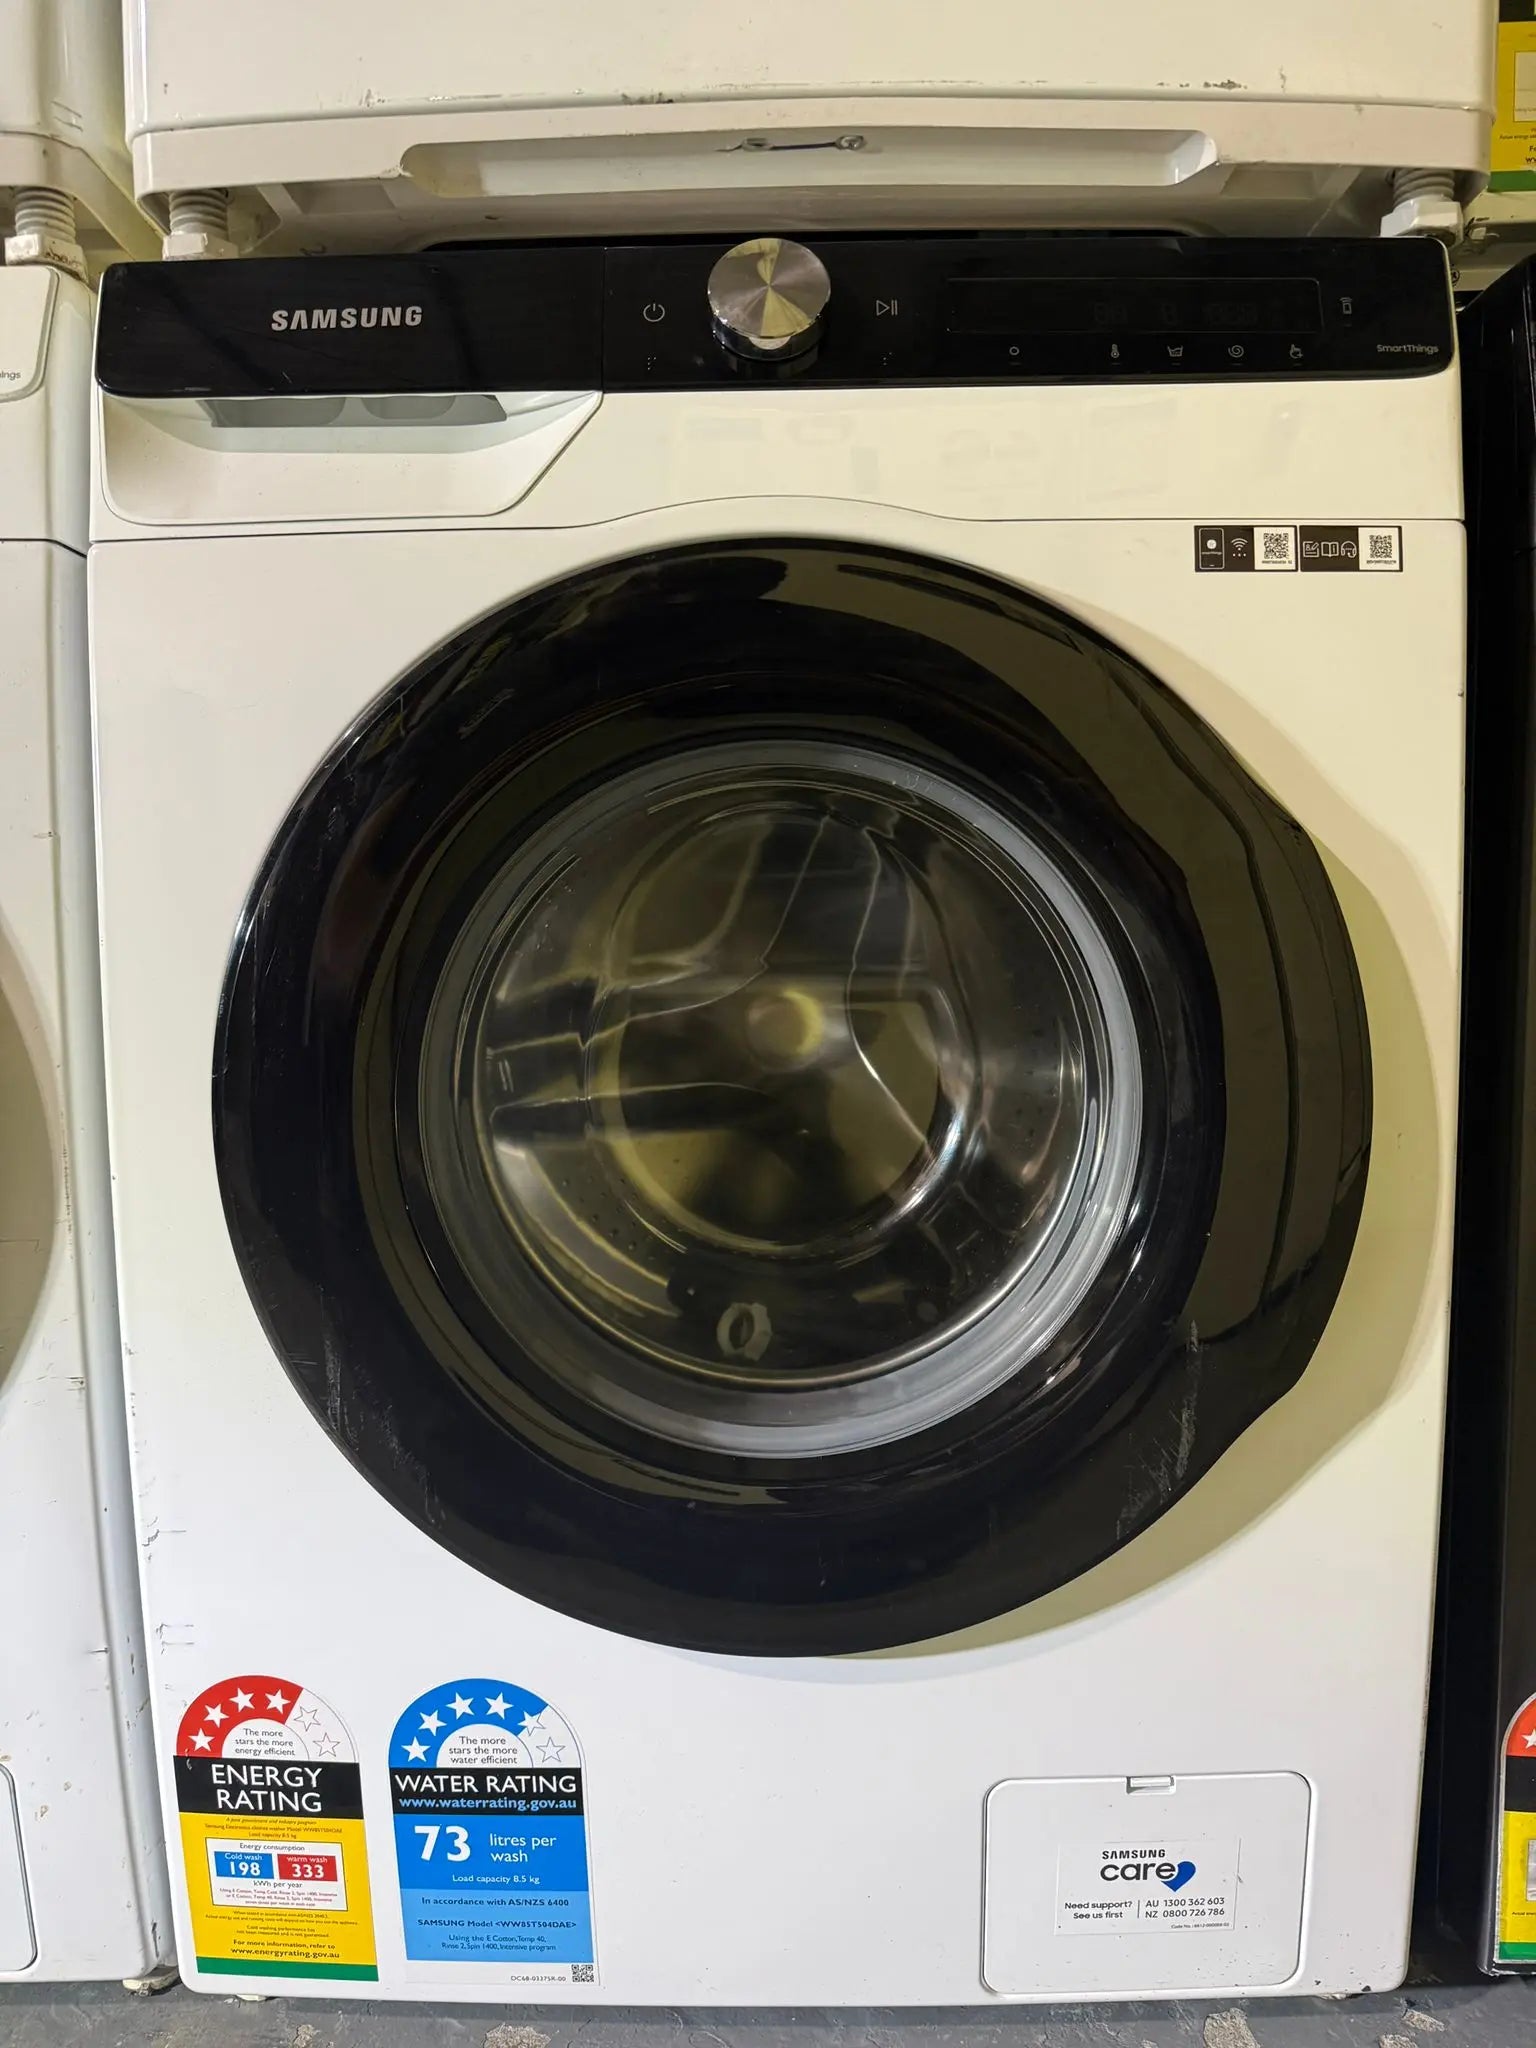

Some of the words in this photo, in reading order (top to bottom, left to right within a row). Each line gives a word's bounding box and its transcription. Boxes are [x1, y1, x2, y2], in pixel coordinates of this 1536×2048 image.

[271, 305, 423, 332] SAMSUNG
[1376, 344, 1439, 355] SmartThings
[243, 1728, 259, 1736] The
[459, 1736, 478, 1745] The
[480, 1737, 505, 1745] more
[264, 1747, 295, 1756] efficient
[474, 1746, 489, 1754] the
[480, 1756, 517, 1764] efficient
[212, 1764, 323, 1788] ENERGY
[395, 1775, 478, 1793] WATER
[487, 1775, 576, 1793] RATING
[217, 1789, 322, 1812] RATING
[399, 1797, 576, 1811] www.waterrating.gov.au
[240, 1843, 261, 1851] Energy
[414, 1825, 470, 1862] 73
[490, 1833, 526, 1846] litres
[532, 1836, 557, 1850] per
[491, 1850, 528, 1863] wash
[1102, 1849, 1166, 1860] SAMSUNG
[230, 1862, 261, 1876] 198
[292, 1864, 324, 1879] 333
[1100, 1862, 1176, 1881] care
[477, 1875, 510, 1884] capacity
[529, 1876, 540, 1884] kg
[421, 1897, 431, 1905] In
[487, 1898, 506, 1906] with
[1091, 1900, 1133, 1910] support?
[1145, 1900, 1159, 1908] AU
[1164, 1899, 1186, 1907] 1300
[1188, 1898, 1206, 1906] 362
[1207, 1897, 1225, 1905] 603
[1105, 1911, 1123, 1919] first
[1145, 1910, 1158, 1918] NZ
[1162, 1909, 1187, 1918] 0800
[1189, 1908, 1206, 1917] 726
[1208, 1907, 1225, 1916] 786
[418, 1919, 465, 1927] SAMSUNG
[449, 1934, 470, 1943] Using
[266, 1941, 309, 1949] information,
[231, 1948, 340, 1959] www.energyrating.gov.au
